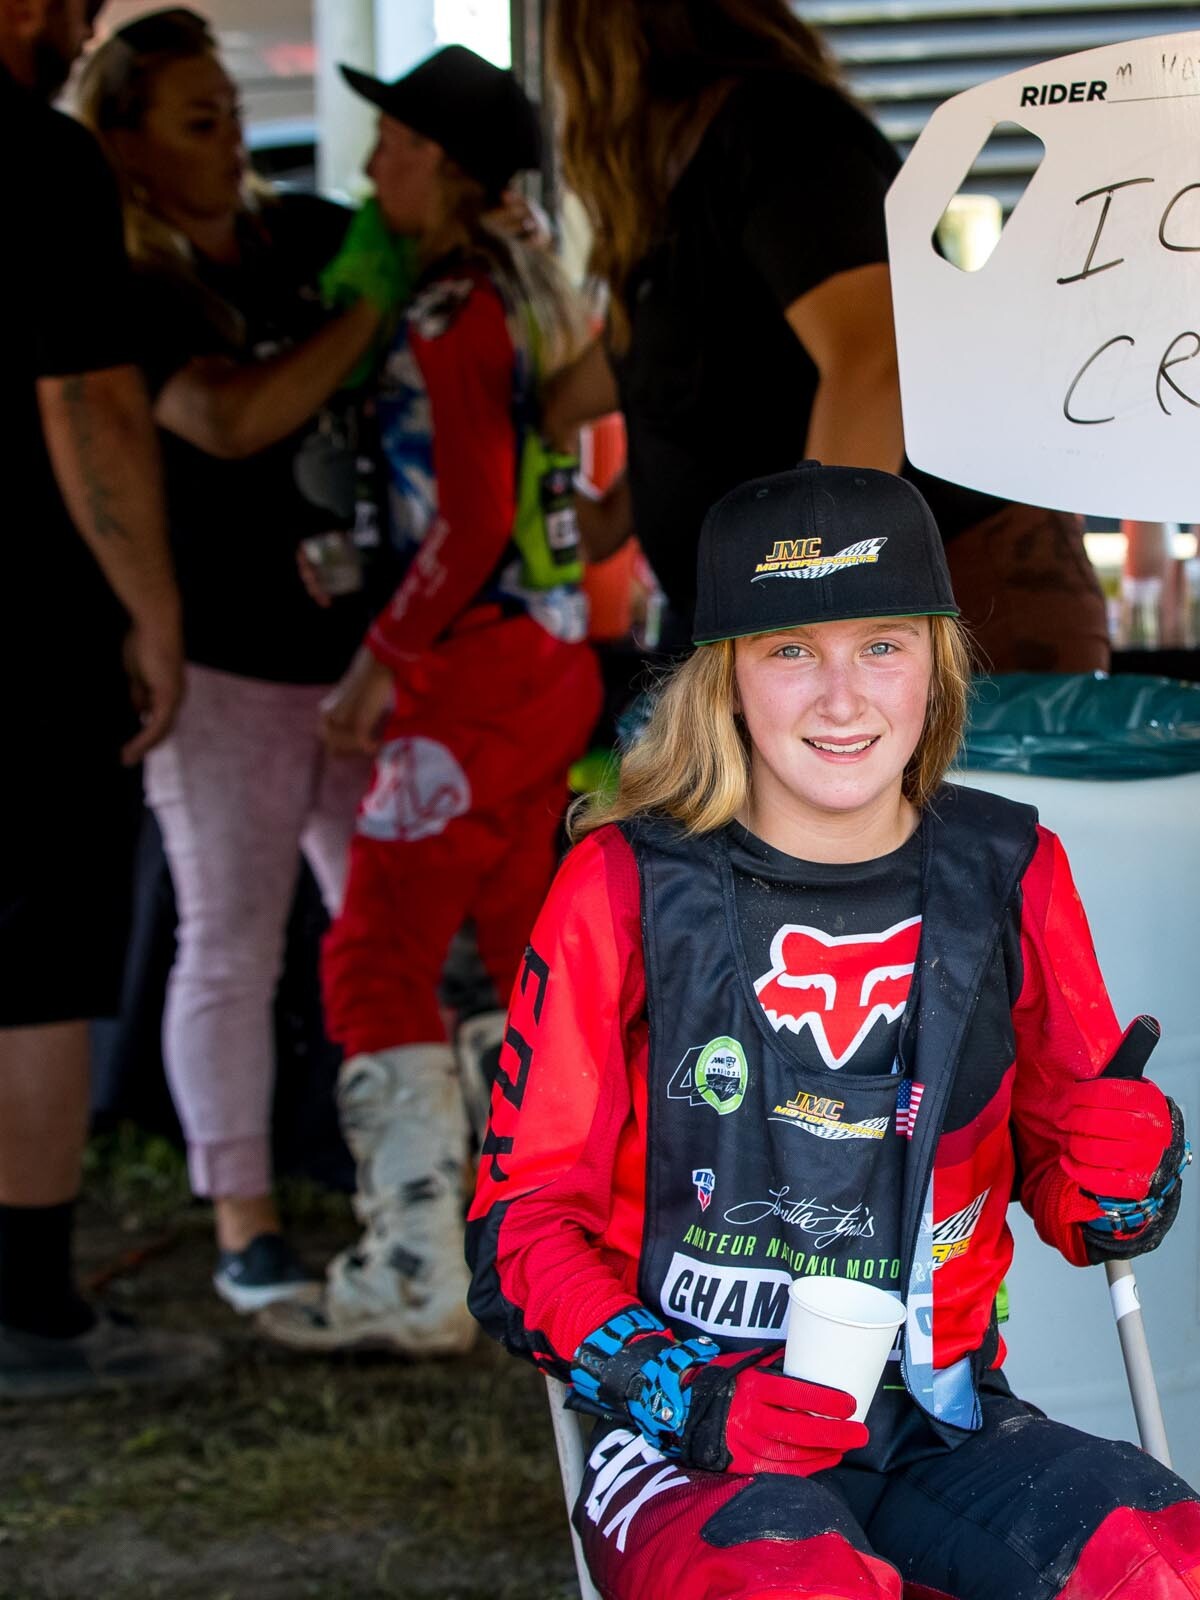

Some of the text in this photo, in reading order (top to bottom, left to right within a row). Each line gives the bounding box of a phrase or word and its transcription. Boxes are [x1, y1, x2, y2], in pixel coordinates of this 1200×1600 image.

[1019, 79, 1108, 107] RIDER
[755, 553, 879, 573] MOTORSPORTS
[765, 537, 823, 563] JMC
[785, 1091, 846, 1120] JMC
[772, 1104, 886, 1140] MOTORSPORTS
[723, 1185, 829, 1229] Loretta
[682, 1224, 757, 1257] AMATEUR
[845, 1257, 901, 1281] MOTO
